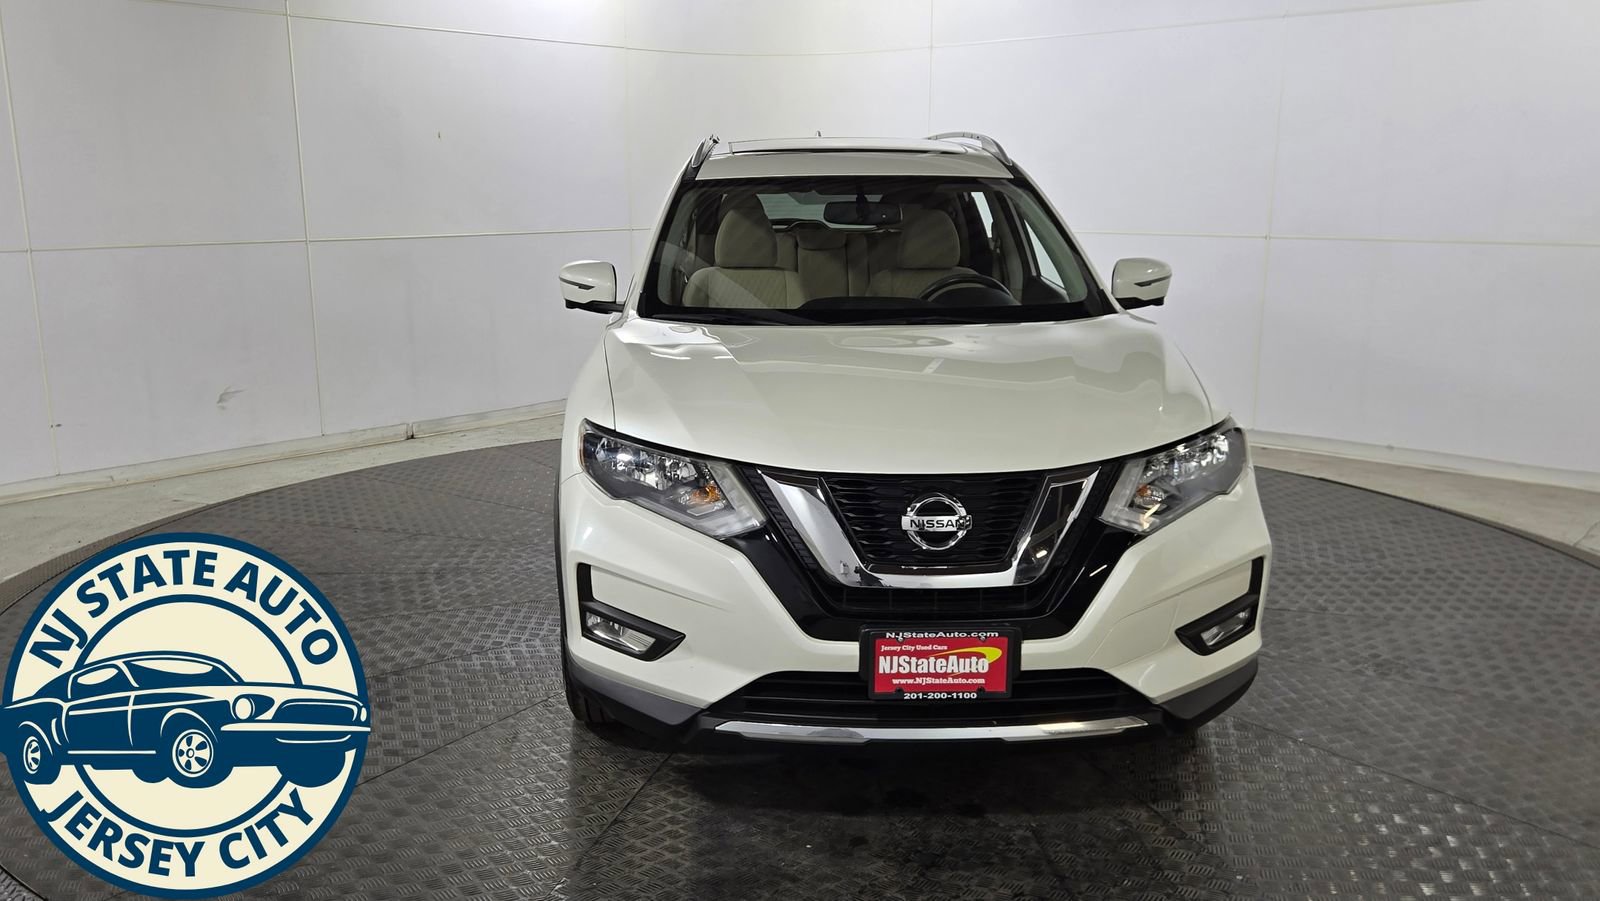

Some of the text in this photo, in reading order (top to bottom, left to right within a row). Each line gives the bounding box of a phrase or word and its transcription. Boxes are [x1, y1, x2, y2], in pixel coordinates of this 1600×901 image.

[910, 519, 965, 529] NISSAN
[902, 644, 915, 652] City
[878, 655, 989, 674] NJStateAuto
[892, 677, 985, 685] www.NJStateAuto.com
